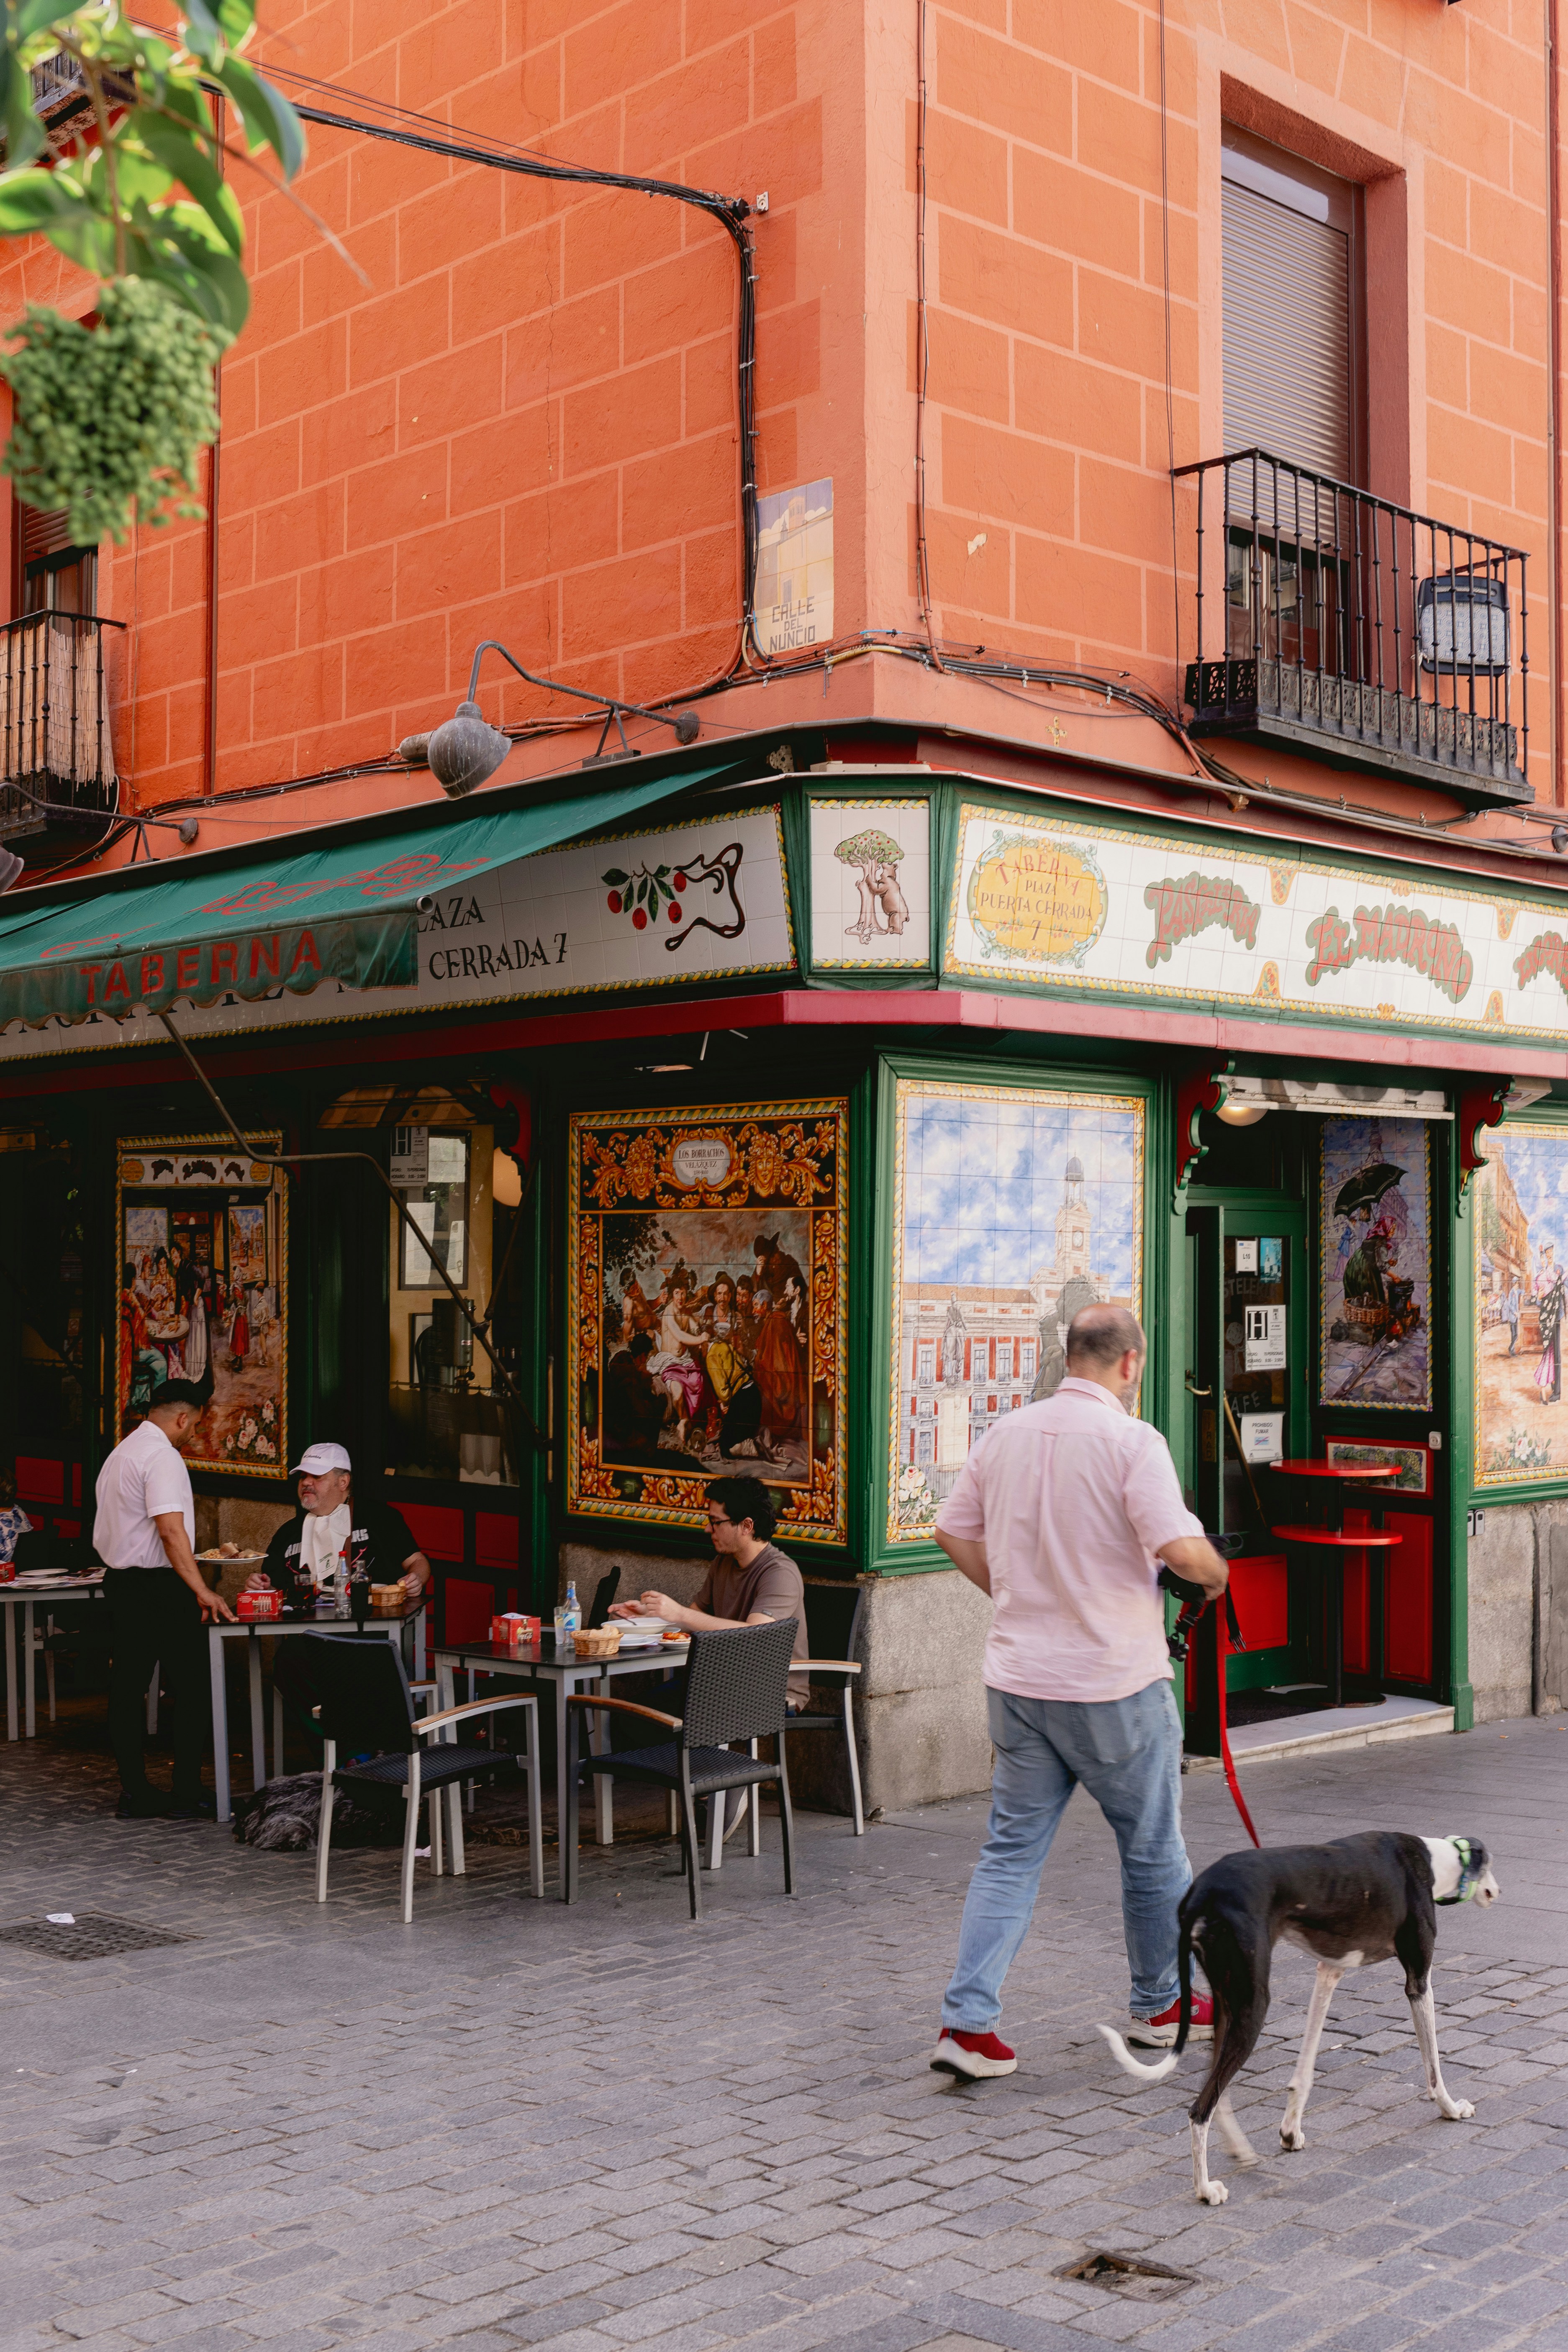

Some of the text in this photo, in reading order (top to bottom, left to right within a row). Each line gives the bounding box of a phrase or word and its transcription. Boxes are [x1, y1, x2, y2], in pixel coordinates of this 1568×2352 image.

[772, 596, 815, 623] CALLE
[770, 625, 816, 652] NUNCIO
[784, 617, 803, 632] DEL
[996, 854, 1082, 896] TABERNA
[1026, 880, 1057, 895] PLAZA
[417, 895, 485, 933] LAZA
[980, 892, 1093, 921] PUERTA CERRADA
[1147, 877, 1257, 961] PASTELERIA
[1031, 920, 1042, 941] 7
[81, 931, 323, 1004] TABERNA
[429, 933, 567, 980] CERRADA 7
[1311, 910, 1471, 996] EL MADROÑO
[394, 1127, 410, 1155] H
[678, 1148, 724, 1159] LOS BORRACHOS
[1248, 1311, 1268, 1340] H
